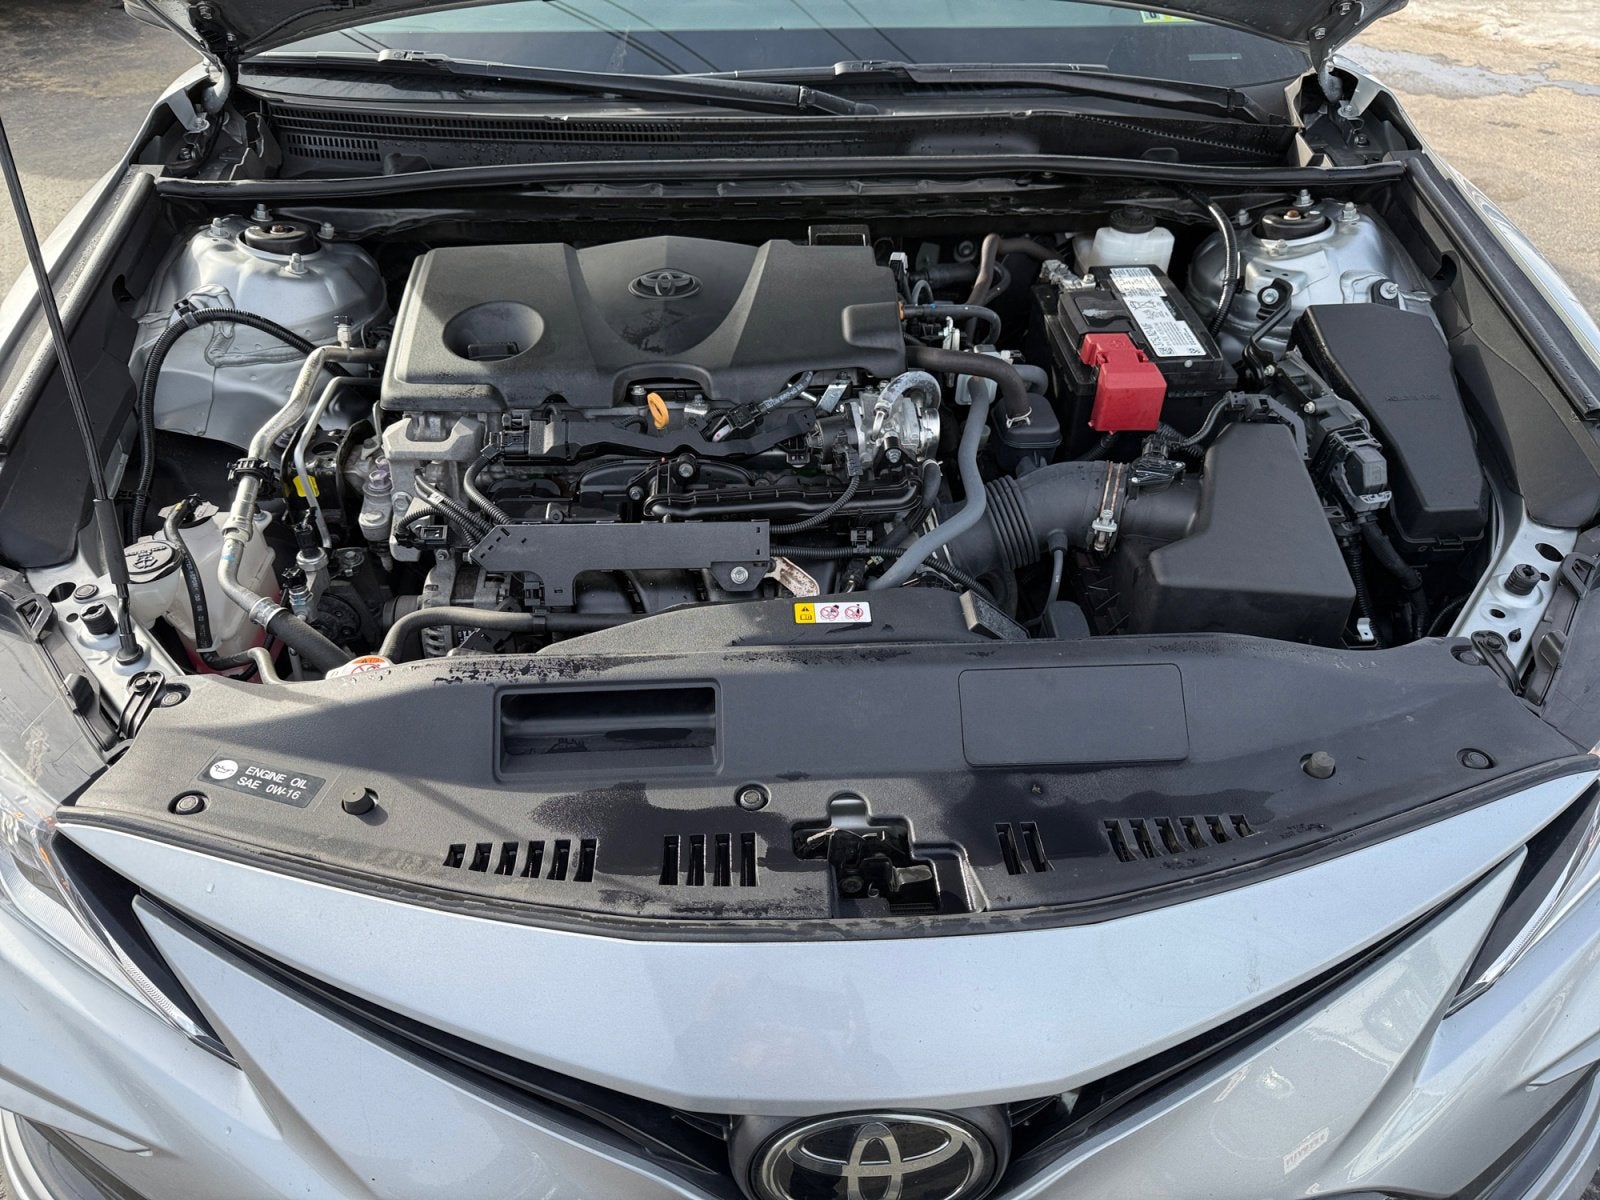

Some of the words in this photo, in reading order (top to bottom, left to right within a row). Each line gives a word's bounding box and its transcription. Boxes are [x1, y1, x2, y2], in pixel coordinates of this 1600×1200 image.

[237, 777, 262, 789] SAE
[265, 784, 302, 799] 0W-16
[245, 766, 287, 783] ENGINE
[290, 777, 307, 789] OIL
